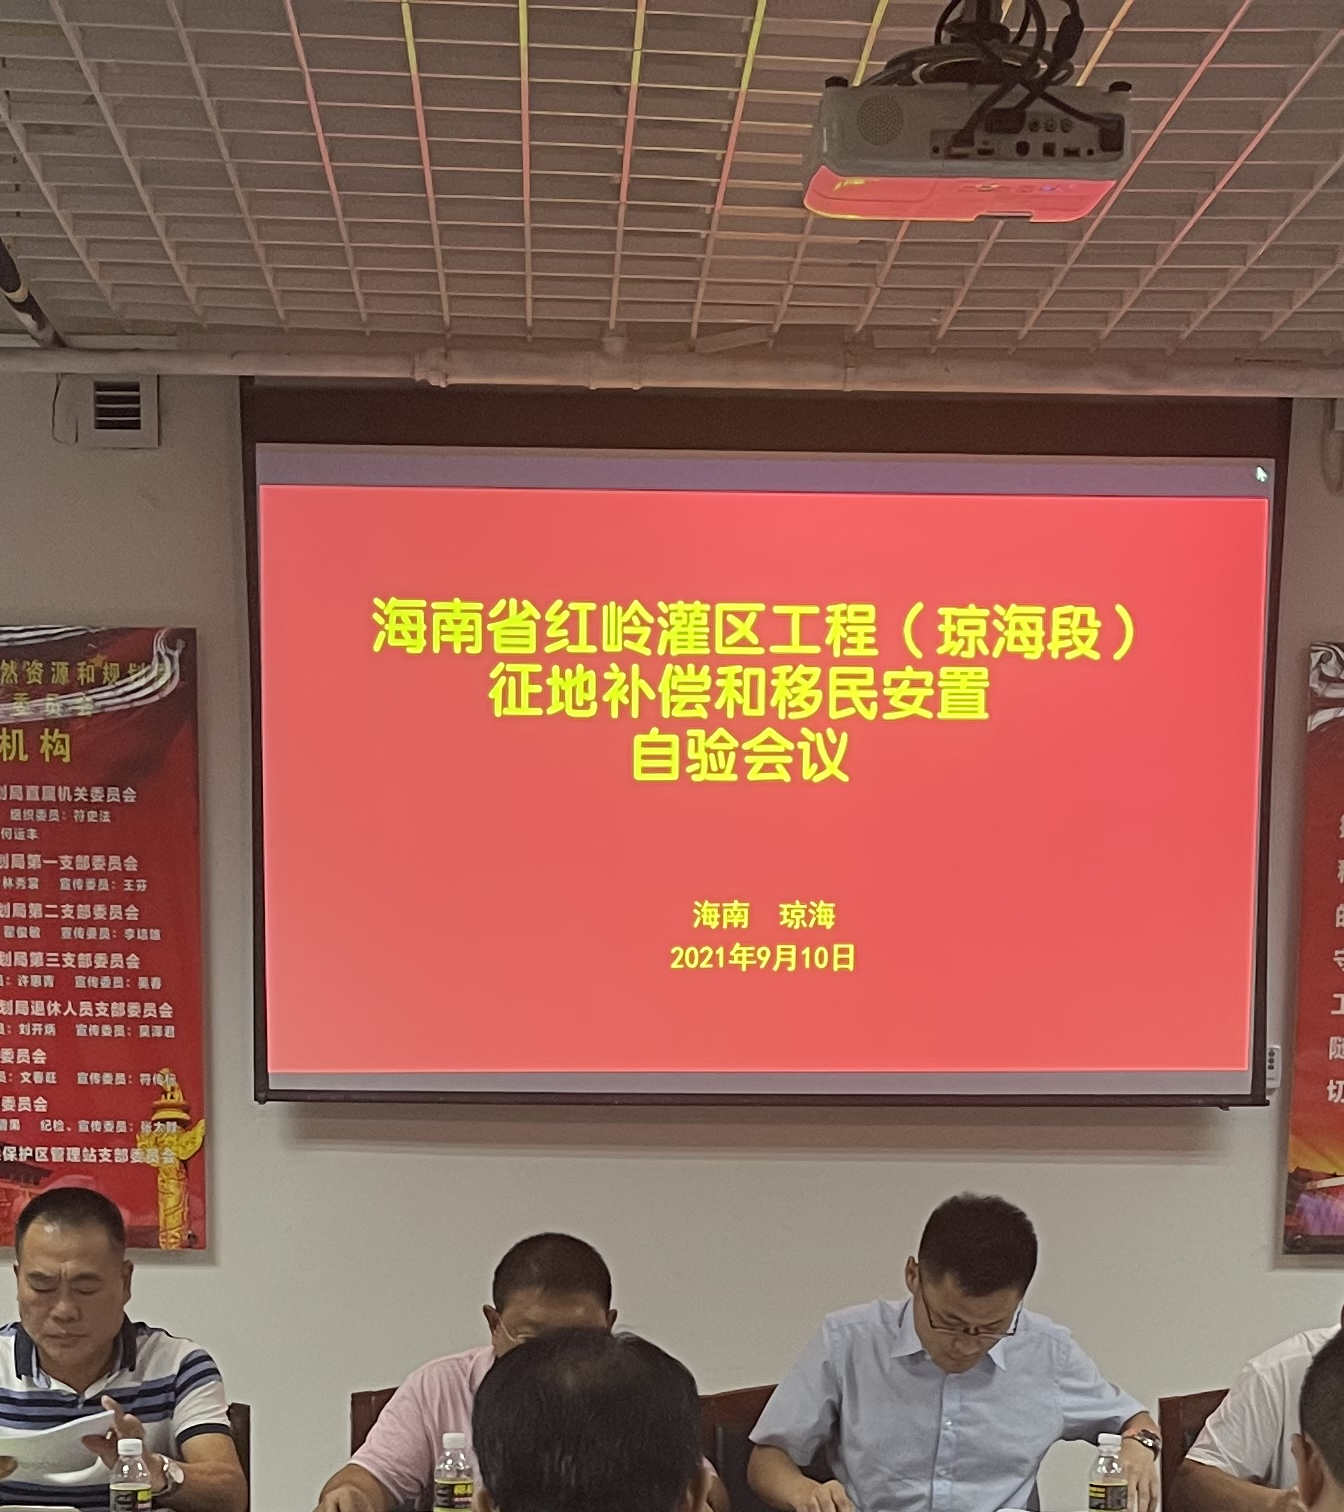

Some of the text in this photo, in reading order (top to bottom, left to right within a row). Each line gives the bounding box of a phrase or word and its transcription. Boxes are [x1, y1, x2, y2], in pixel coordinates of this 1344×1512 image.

[372, 596, 1141, 662] 海南省红岭灌区工程（琼海段）
[490, 662, 990, 722] 征地补偿和移民安置
[632, 728, 850, 785] 自验会议
[692, 900, 837, 931] 海南 琼海
[670, 942, 857, 974] 2021年9月10日
